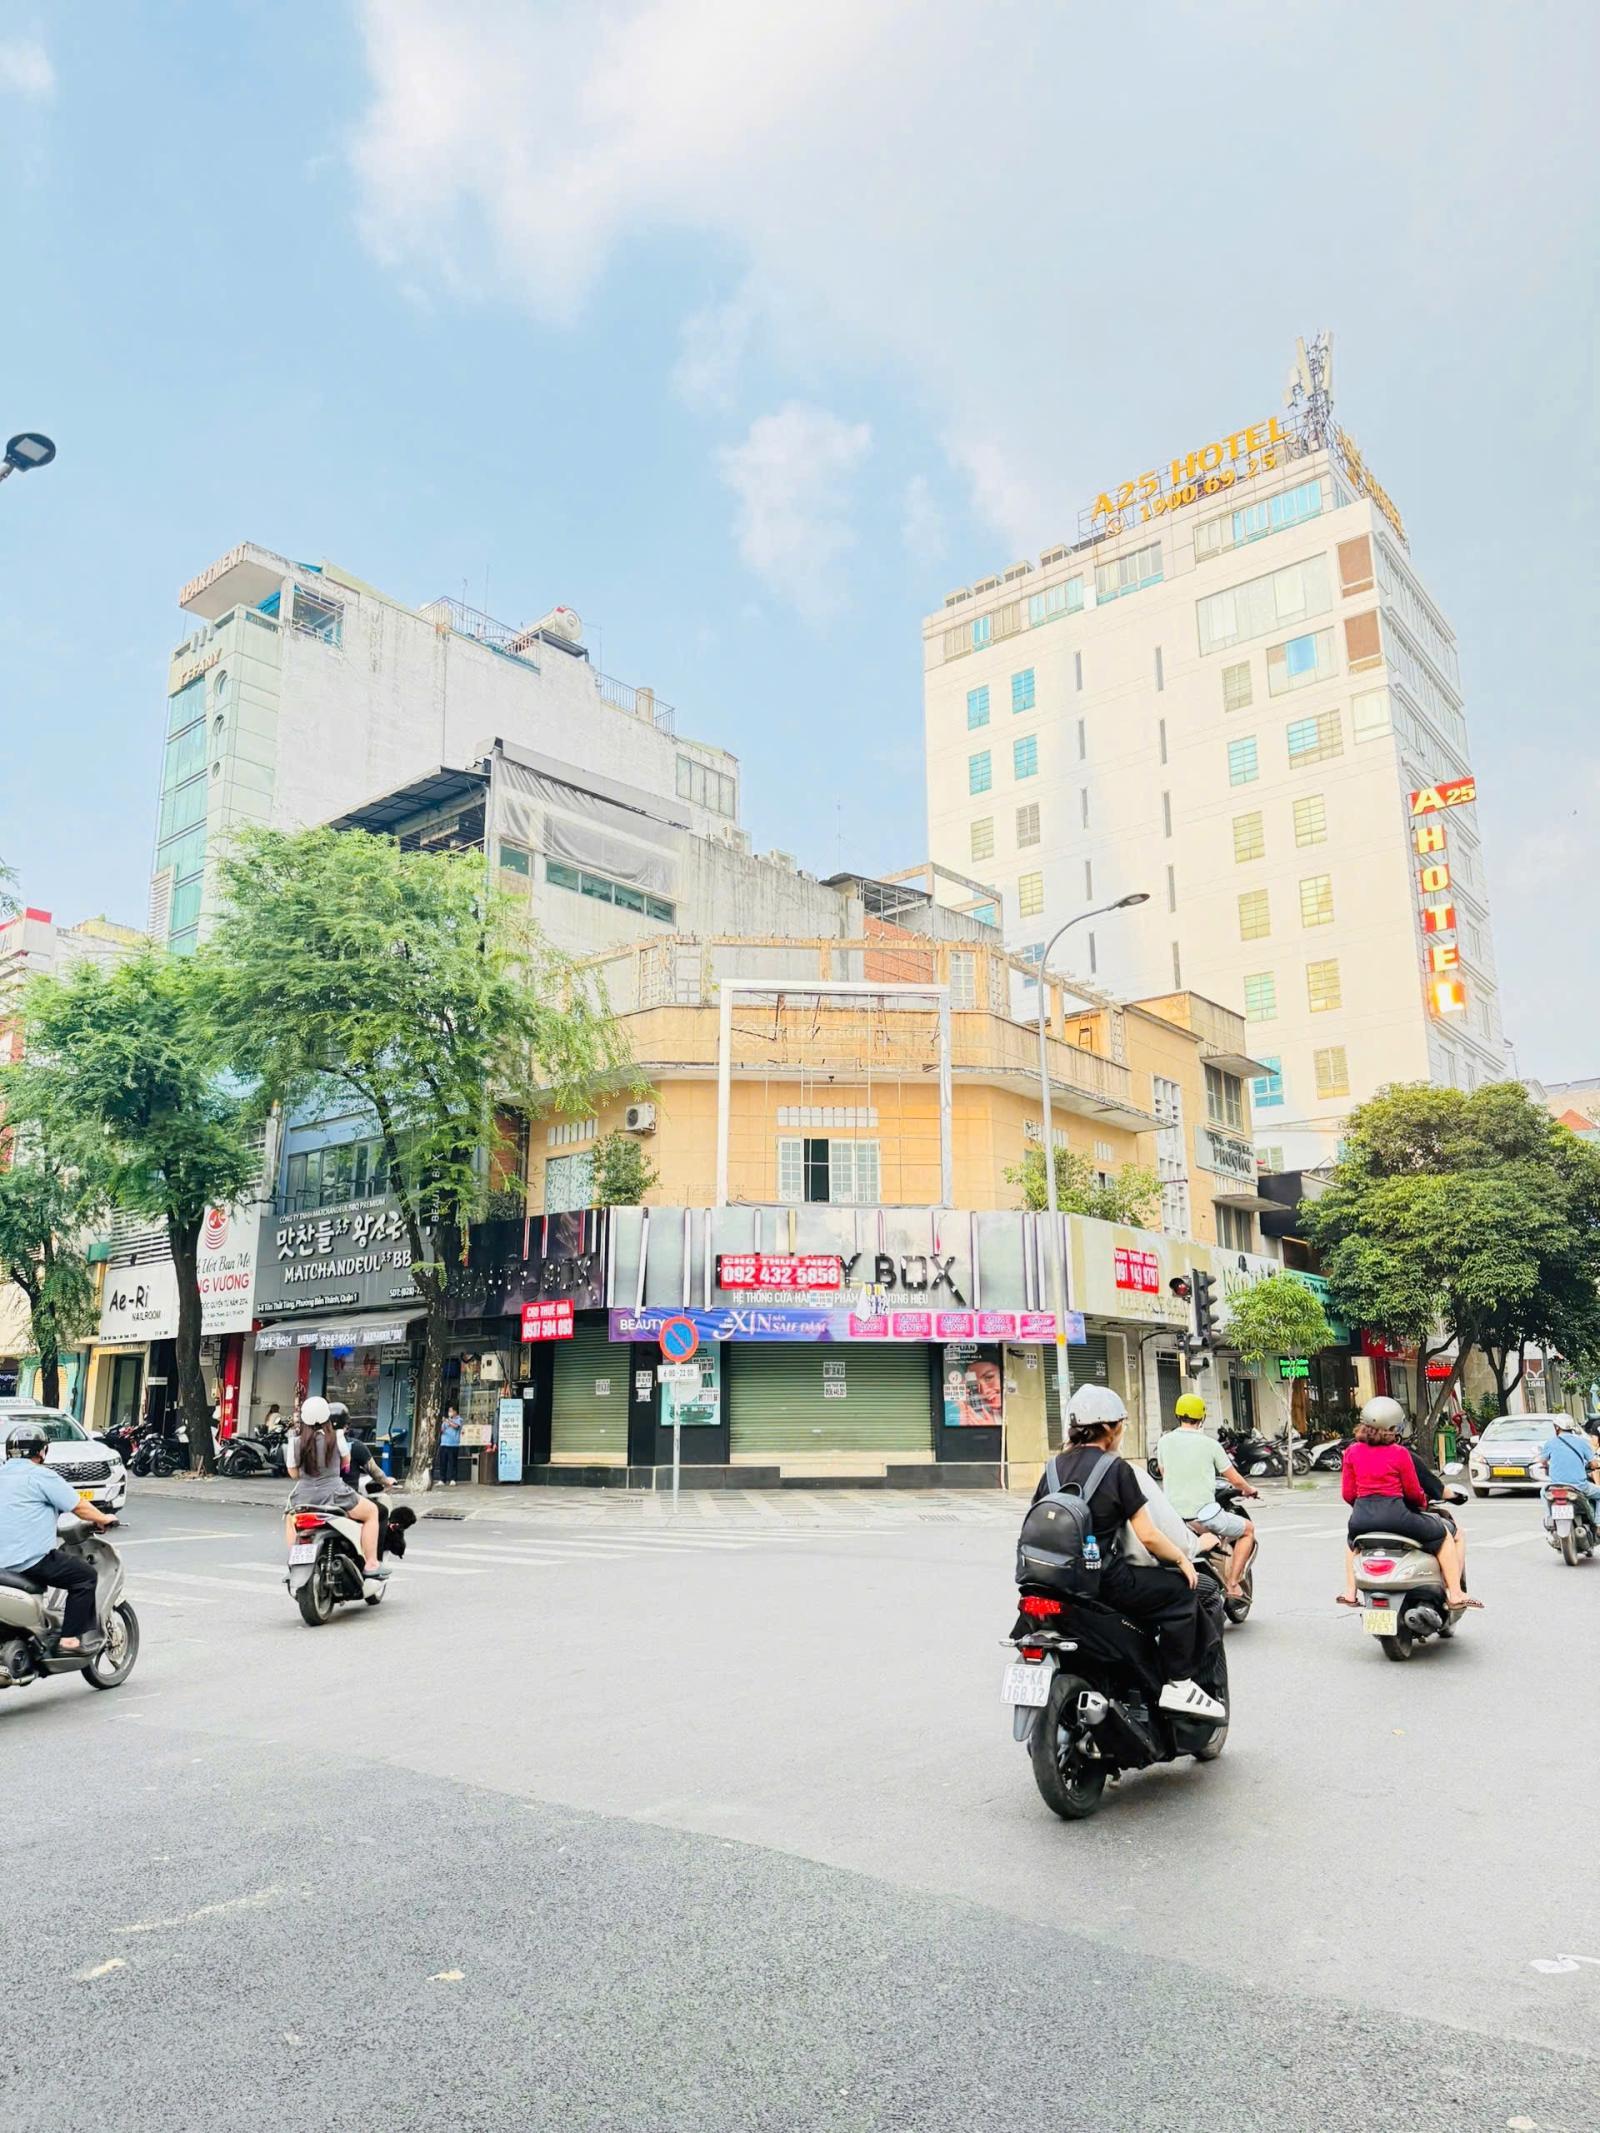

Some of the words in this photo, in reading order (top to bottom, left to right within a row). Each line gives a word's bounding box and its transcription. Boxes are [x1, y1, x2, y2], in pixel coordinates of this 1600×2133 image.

[1091, 471, 1158, 520] A25
[1170, 416, 1292, 485] HOTEL
[1139, 488, 1196, 522] 1900
[1204, 471, 1235, 494] 69
[1247, 452, 1276, 479] 25
[1412, 783, 1476, 815] A25
[1416, 825, 1465, 1014] HOTEL
[213, 1273, 249, 1292] VƯƠNG
[284, 1255, 382, 1284] MATCHANDEUL
[393, 1250, 412, 1269] BB
[722, 1266, 756, 1283] 092
[760, 1267, 793, 1283] 432
[797, 1267, 838, 1284] 5858
[875, 1254, 967, 1307] BOX
[109, 1285, 150, 1312] Ae-Ri
[132, 1311, 161, 1321] NAILROOM
